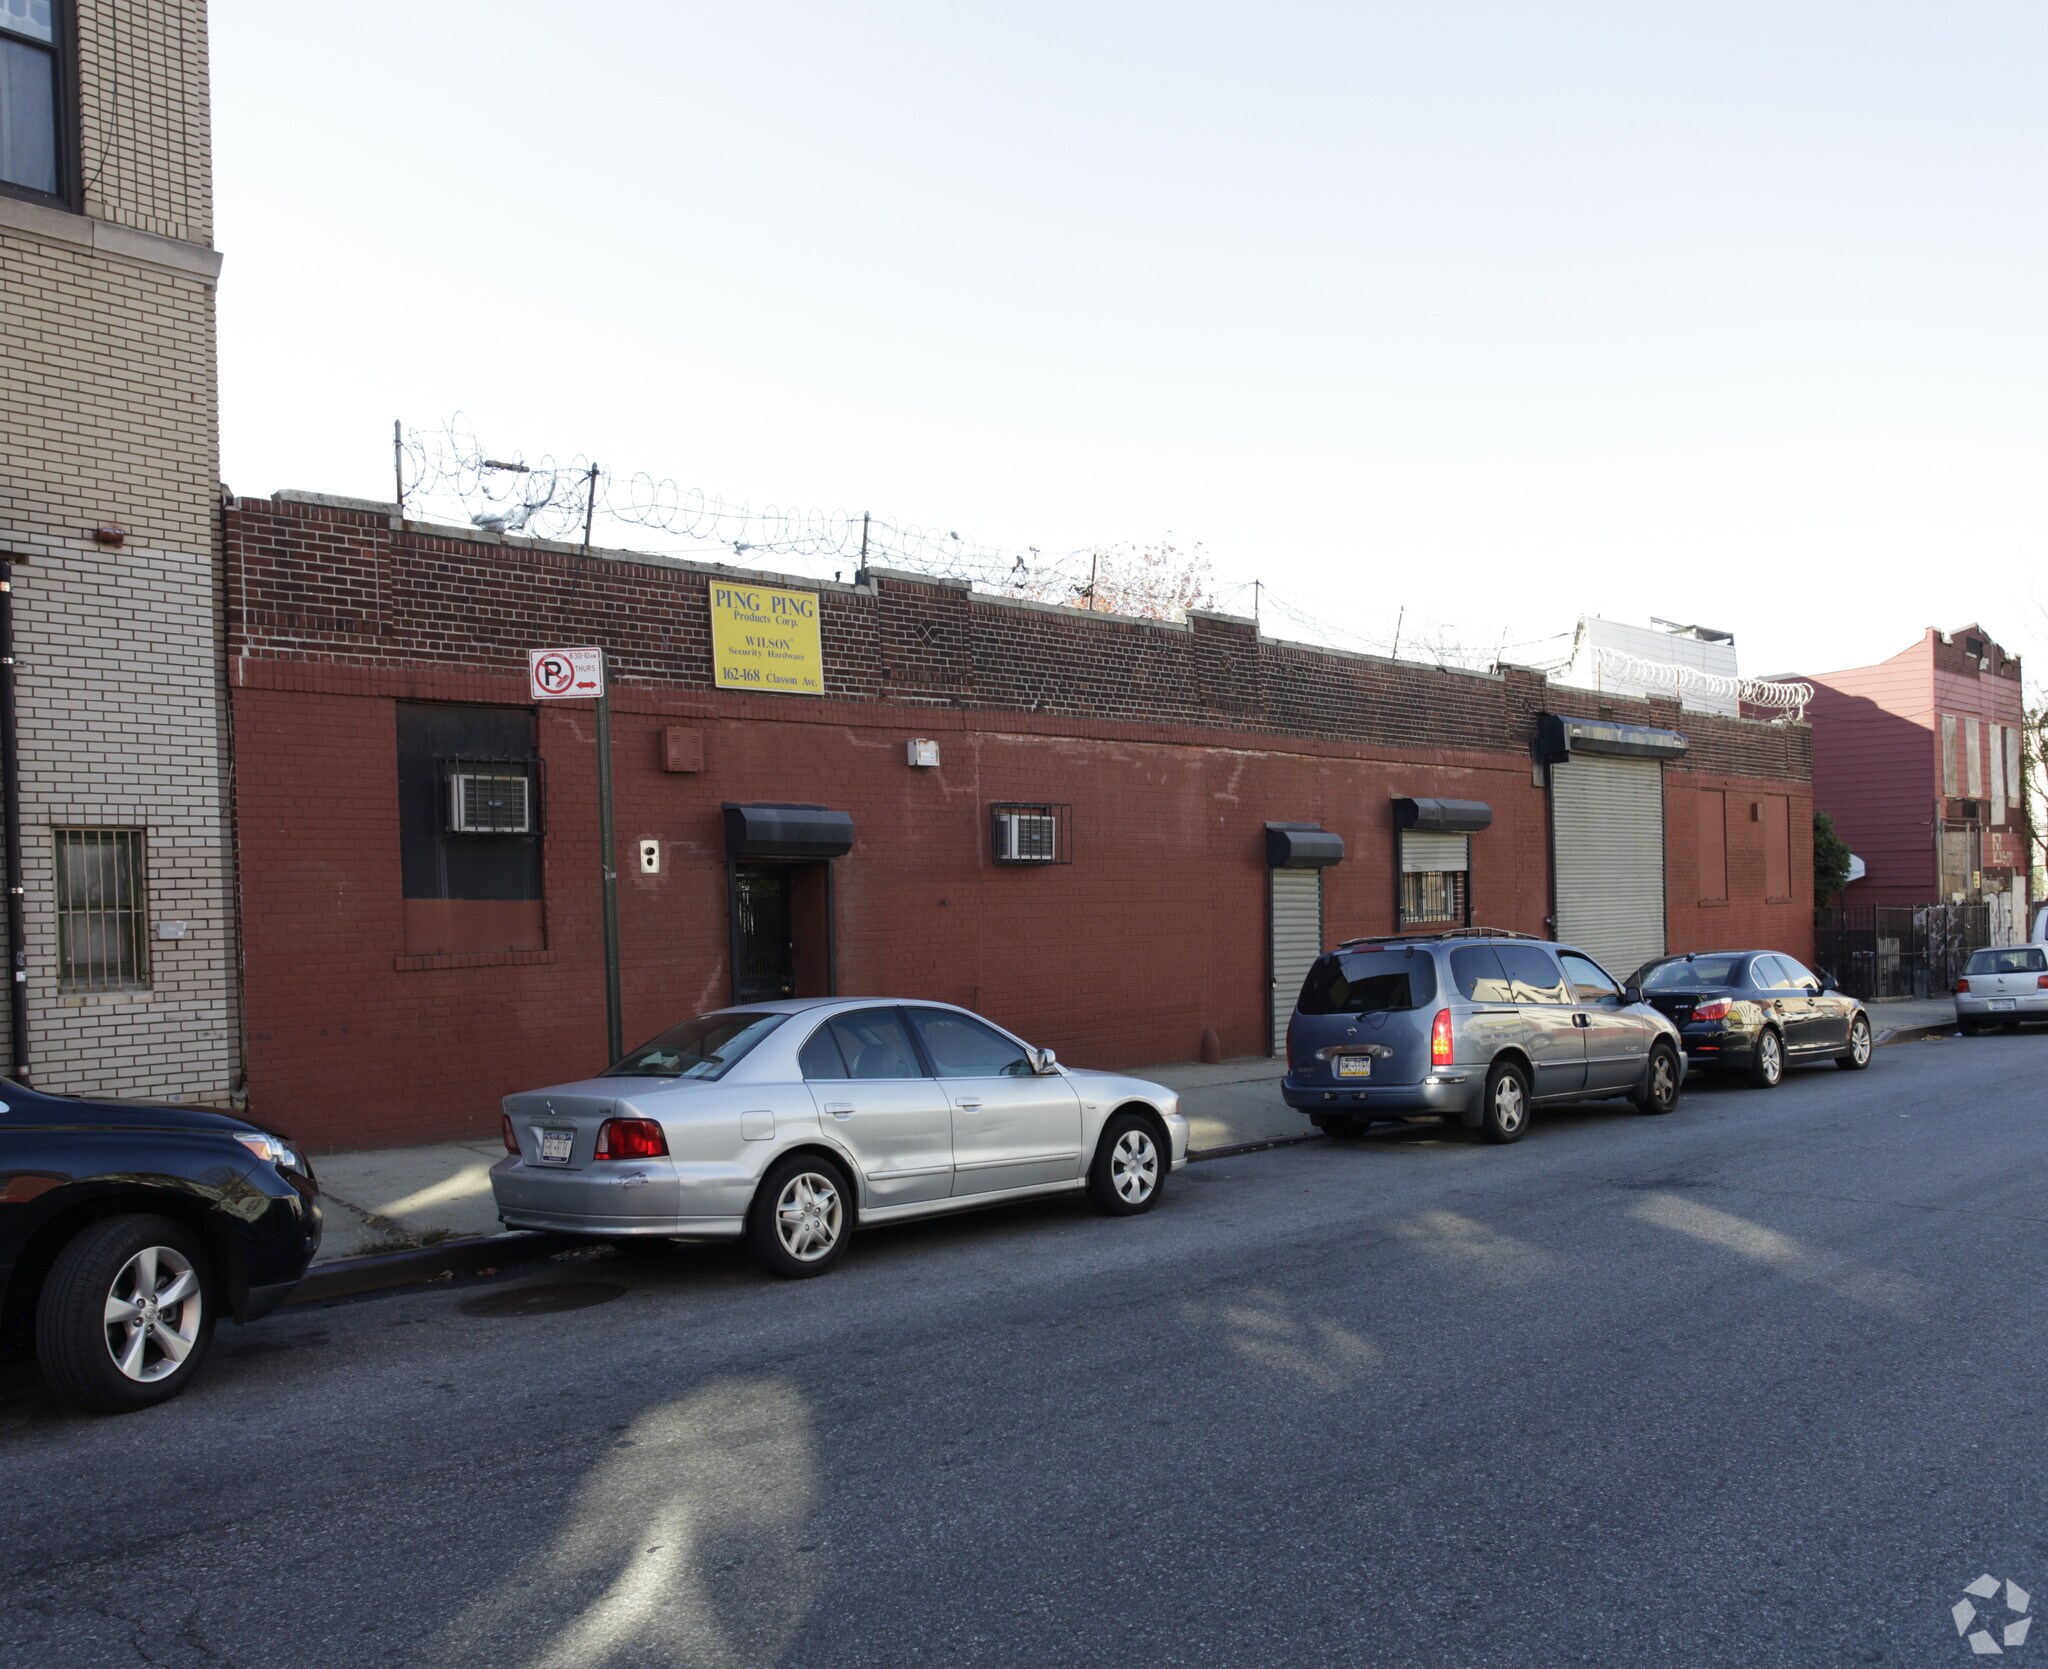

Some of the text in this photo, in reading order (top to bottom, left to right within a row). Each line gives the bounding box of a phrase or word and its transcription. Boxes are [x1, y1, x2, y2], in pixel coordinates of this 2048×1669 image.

[715, 589, 813, 618] PING PING
[733, 610, 798, 629] Products Corp.
[728, 646, 805, 661] Security Hardware
[575, 664, 596, 672] THURS
[722, 667, 818, 687] 162-168 Classon Ave.
